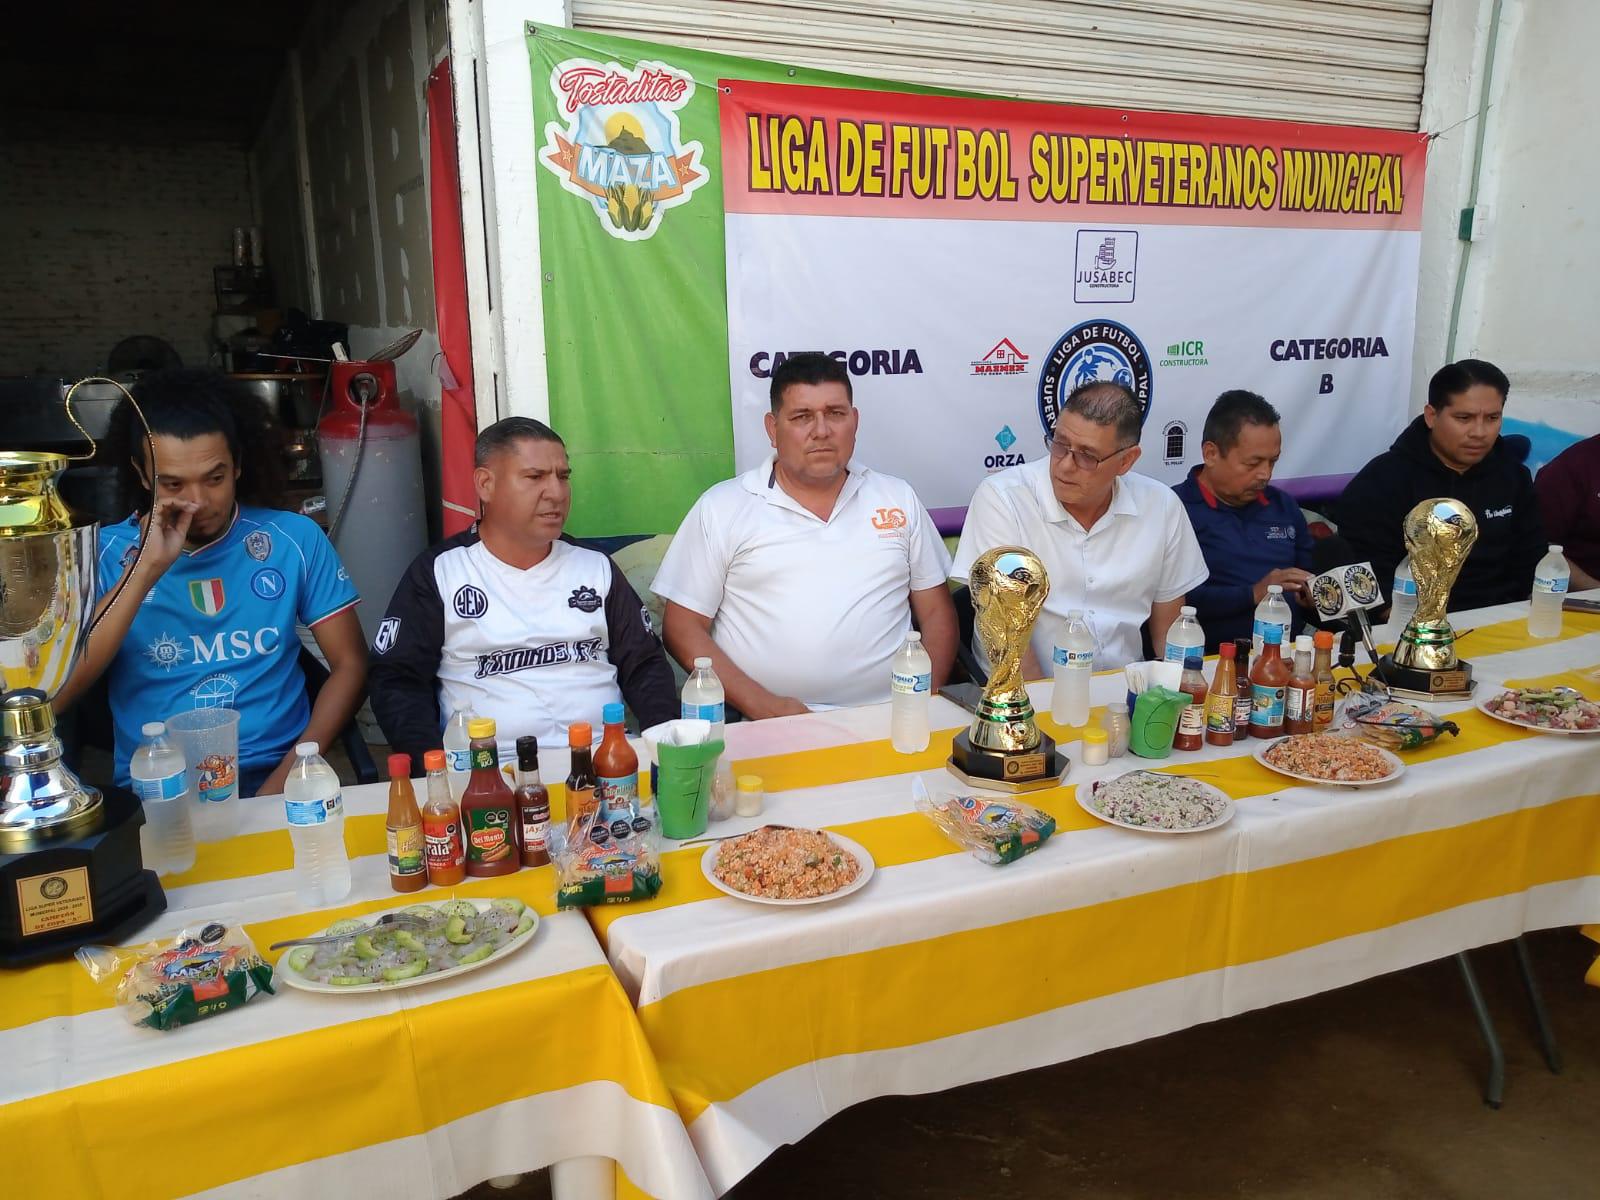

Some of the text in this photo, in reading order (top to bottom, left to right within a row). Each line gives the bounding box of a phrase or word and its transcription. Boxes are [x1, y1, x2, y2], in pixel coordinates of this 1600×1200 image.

[560, 67, 687, 113] Tostaditas
[579, 145, 678, 190] MAZA
[746, 112, 833, 195] LIGA
[837, 118, 887, 197] DE
[1029, 131, 1279, 211] SUPERVETERANOS
[1279, 147, 1405, 214] MUNICIPAL
[1077, 271, 1133, 283] JUSABEC
[1053, 326, 1141, 366] LIGA DE FUTBOL
[1182, 341, 1203, 356] ICR
[1270, 337, 1389, 361] CATEGORIA
[1159, 358, 1208, 367] CONSTRUCTORA
[1318, 373, 1334, 395] B
[984, 453, 1026, 468] ORZA
[261, 575, 277, 594] N
[189, 627, 279, 664] MSC
